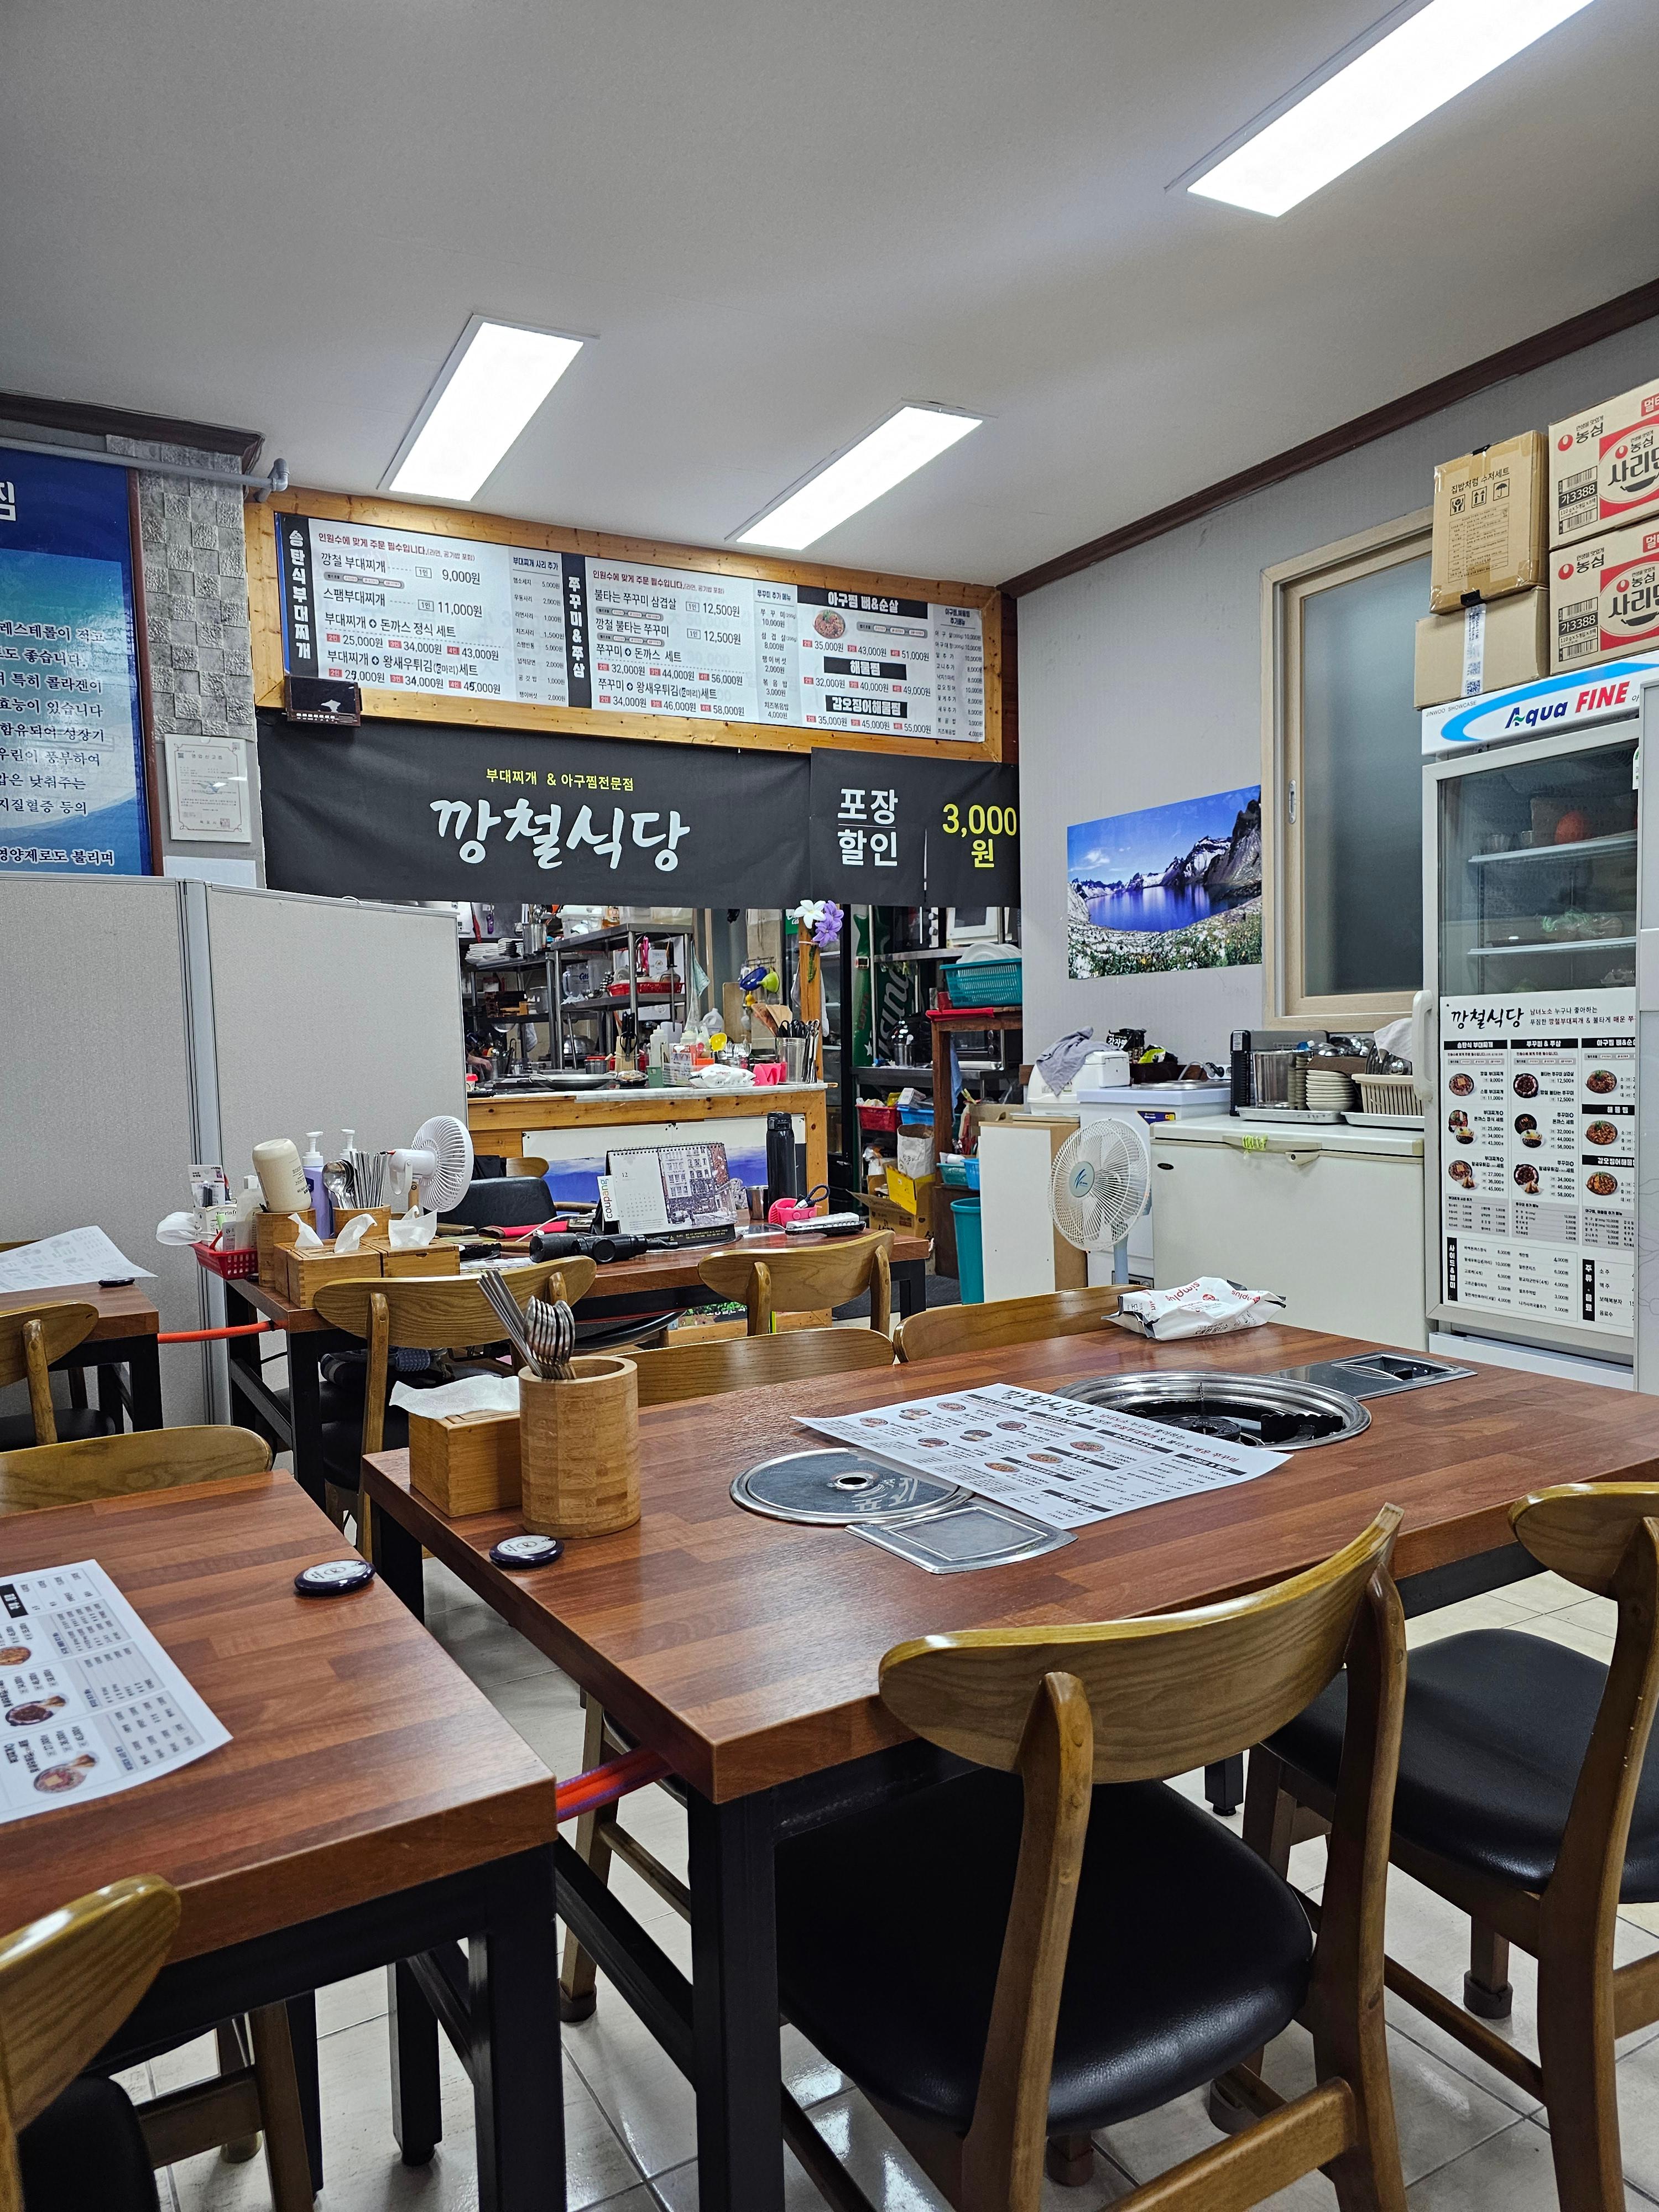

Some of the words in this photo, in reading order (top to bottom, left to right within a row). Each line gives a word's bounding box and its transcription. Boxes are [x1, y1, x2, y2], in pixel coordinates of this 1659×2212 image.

[1576, 422, 1604, 444] 농심
[1631, 436, 1653, 453] 농심
[1452, 477, 1479, 494] 집밥처럼
[1481, 467, 1510, 484] 수저세트
[1561, 484, 1595, 504] 가3388
[319, 533, 350, 544] 인원수에
[353, 538, 368, 547] 맞게
[371, 540, 385, 550] 주문
[321, 553, 342, 567] 깡철
[346, 556, 385, 573] 부대찌개
[442, 570, 480, 585] 9,000원
[536, 560, 546, 569] 사리
[548, 562, 558, 570] 추가
[1577, 554, 1604, 573] 농심
[593, 570, 619, 581] 인원수에
[621, 575, 634, 583] 맞게
[637, 576, 649, 585] 주문
[1631, 572, 1655, 587] 농심
[289, 530, 311, 659] 송탄식부대찌개
[324, 588, 385, 607] 스팸부대찌개
[439, 602, 482, 618] 11,000원
[594, 589, 620, 604] 불타는
[623, 593, 649, 607] 쭈꾸미
[651, 596, 676, 611] 삼겹살
[703, 603, 740, 617] 12,500원
[828, 591, 858, 609] 아구찜
[325, 612, 366, 629] 부대찌개
[380, 619, 411, 633] 돈까스
[414, 623, 433, 635] 정식
[437, 625, 456, 637] 세트
[596, 618, 613, 631] 깡철
[616, 620, 641, 634] 불타는
[644, 624, 669, 637] 쭈꾸미
[704, 630, 741, 645] 12,500원
[1561, 614, 1595, 633] 가3388
[78, 629, 105, 642] 적고
[24, 649, 85, 666] 좋습니다.
[327, 650, 368, 666] 부대찌개
[343, 635, 383, 648] 25,000원
[404, 641, 442, 655] 34,000원
[462, 648, 499, 661] 43,000원
[597, 644, 622, 658] 쭈꾸미
[635, 648, 660, 660] 돈까스
[665, 650, 681, 662] 세트
[815, 640, 844, 653] 35,000원
[858, 646, 886, 658] 43,000원
[902, 650, 929, 661] 51,000원
[612, 664, 645, 676] 32,000원
[662, 669, 695, 681] 44,000원
[711, 674, 743, 686] 56,000원
[851, 660, 880, 676] 해물찜
[12, 673, 39, 688] 특히
[598, 678, 624, 692] 쭈꾸미
[816, 677, 846, 689] 32,000원
[860, 681, 889, 692] 40,000원
[904, 686, 931, 697] 49,000원
[48, 701, 103, 718] 있습니다
[613, 696, 646, 708] 34,000원
[664, 701, 696, 713] 46,000원
[713, 705, 745, 717] 58,000원
[832, 697, 901, 716] 갑오징어해물찜
[1426, 708, 1446, 717] JINWOO
[1448, 701, 1477, 712] SHOWCASE
[1505, 702, 1568, 729] Aqua
[1575, 681, 1630, 713] FINE
[64, 727, 103, 742] 성장기
[818, 716, 847, 727] 35,000원
[862, 719, 889, 730] 45,000원
[905, 723, 931, 734] 55,000원
[45, 751, 100, 766] 풍부하여
[29, 775, 86, 790] 낮춰주는
[487, 769, 537, 785] 부대찌개
[547, 773, 556, 786] &
[561, 774, 633, 791] 아구찜전문점
[59, 801, 86, 815] 등의
[838, 789, 898, 825] 포장
[942, 804, 1016, 838] 3,000
[430, 798, 690, 872] 깡철식당
[72, 851, 113, 865] 불리며
[838, 830, 898, 866] 할인
[971, 839, 994, 868] 원
[1451, 1008, 1524, 1029] 깡철식당
[601, 1179, 613, 1219] coupang
[1165, 1282, 1200, 1302] simplus
[1001, 1390, 1093, 1416] 깡철식당
